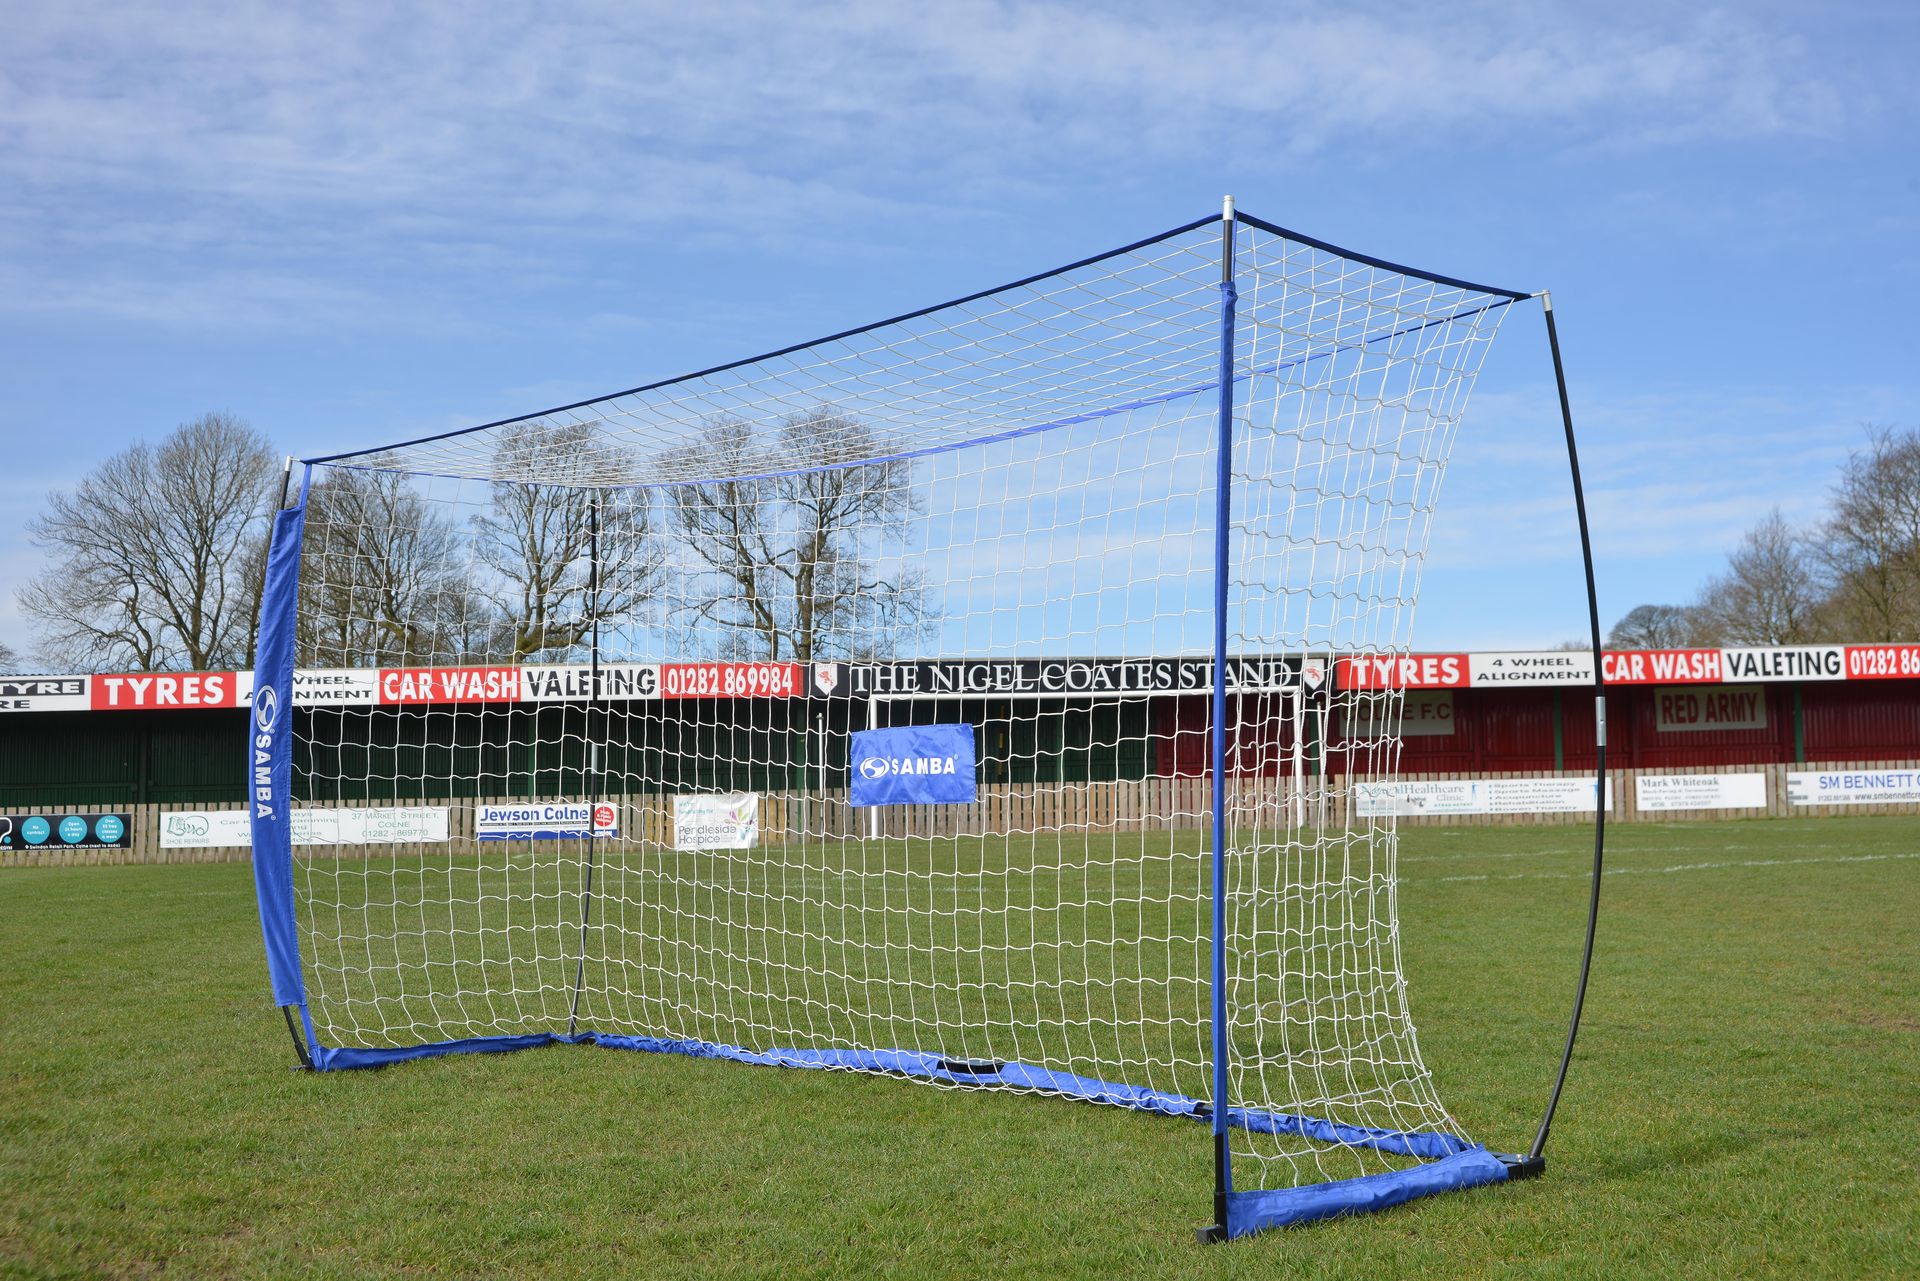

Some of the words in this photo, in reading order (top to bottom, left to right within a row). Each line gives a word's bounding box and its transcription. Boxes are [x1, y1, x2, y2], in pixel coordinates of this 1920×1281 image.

[1352, 657, 1460, 686] TYRES
[1492, 659, 1504, 667] 4
[1511, 658, 1575, 667] WHEEL
[1602, 653, 1646, 681] CAR
[1650, 651, 1720, 680] WASH
[1726, 650, 1841, 677] VALETING
[1850, 649, 1898, 676] 01282
[1900, 648, 1920, 675] 86
[383, 672, 434, 701] CAR
[440, 670, 518, 700] WASH
[526, 669, 656, 697] VALETING
[667, 668, 718, 694] 01282
[724, 667, 793, 693] 869984
[850, 664, 921, 693] THE
[928, 664, 1034, 691] NIGEL
[1042, 663, 1172, 690] COATES
[1179, 661, 1292, 689] STAND
[1477, 670, 1591, 681] ALIGNMENT
[104, 676, 224, 706] TYRES
[244, 690, 372, 699] ANMENT
[1342, 703, 1414, 721] COLNE
[1661, 694, 1699, 725] RED
[1705, 692, 1760, 724] ARMY
[255, 734, 273, 818] SAMBA
[891, 757, 956, 776] SAMBA
[1641, 778, 1669, 788] Mark
[1819, 775, 1840, 790] SM
[1844, 774, 1913, 789] BENNETT
[366, 812, 395, 820] MARKET
[480, 808, 540, 822] Jewson
[544, 806, 589, 821] Colne
[362, 830, 389, 838] 01282
[396, 829, 429, 837] 869770
[679, 834, 721, 845] Hospice
